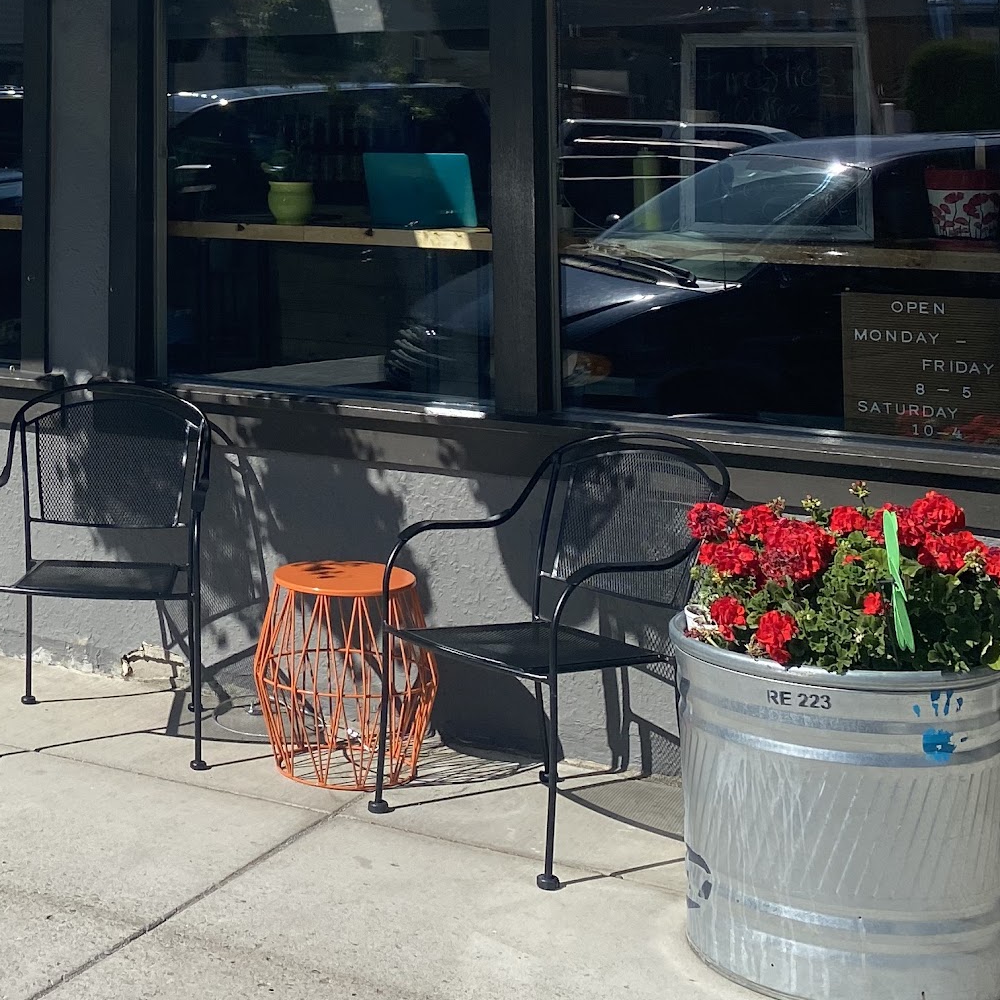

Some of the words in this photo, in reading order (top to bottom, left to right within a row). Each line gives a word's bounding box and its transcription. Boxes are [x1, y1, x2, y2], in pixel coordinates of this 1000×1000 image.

[890, 300, 946, 315] OPEN
[854, 328, 940, 345] MONDAY
[922, 359, 995, 376] FRIDAY
[915, 383, 925, 396] 8
[962, 386, 972, 399] 5
[857, 400, 958, 420] SATURDAY
[766, 689, 792, 706] RE
[797, 692, 833, 710] 223
